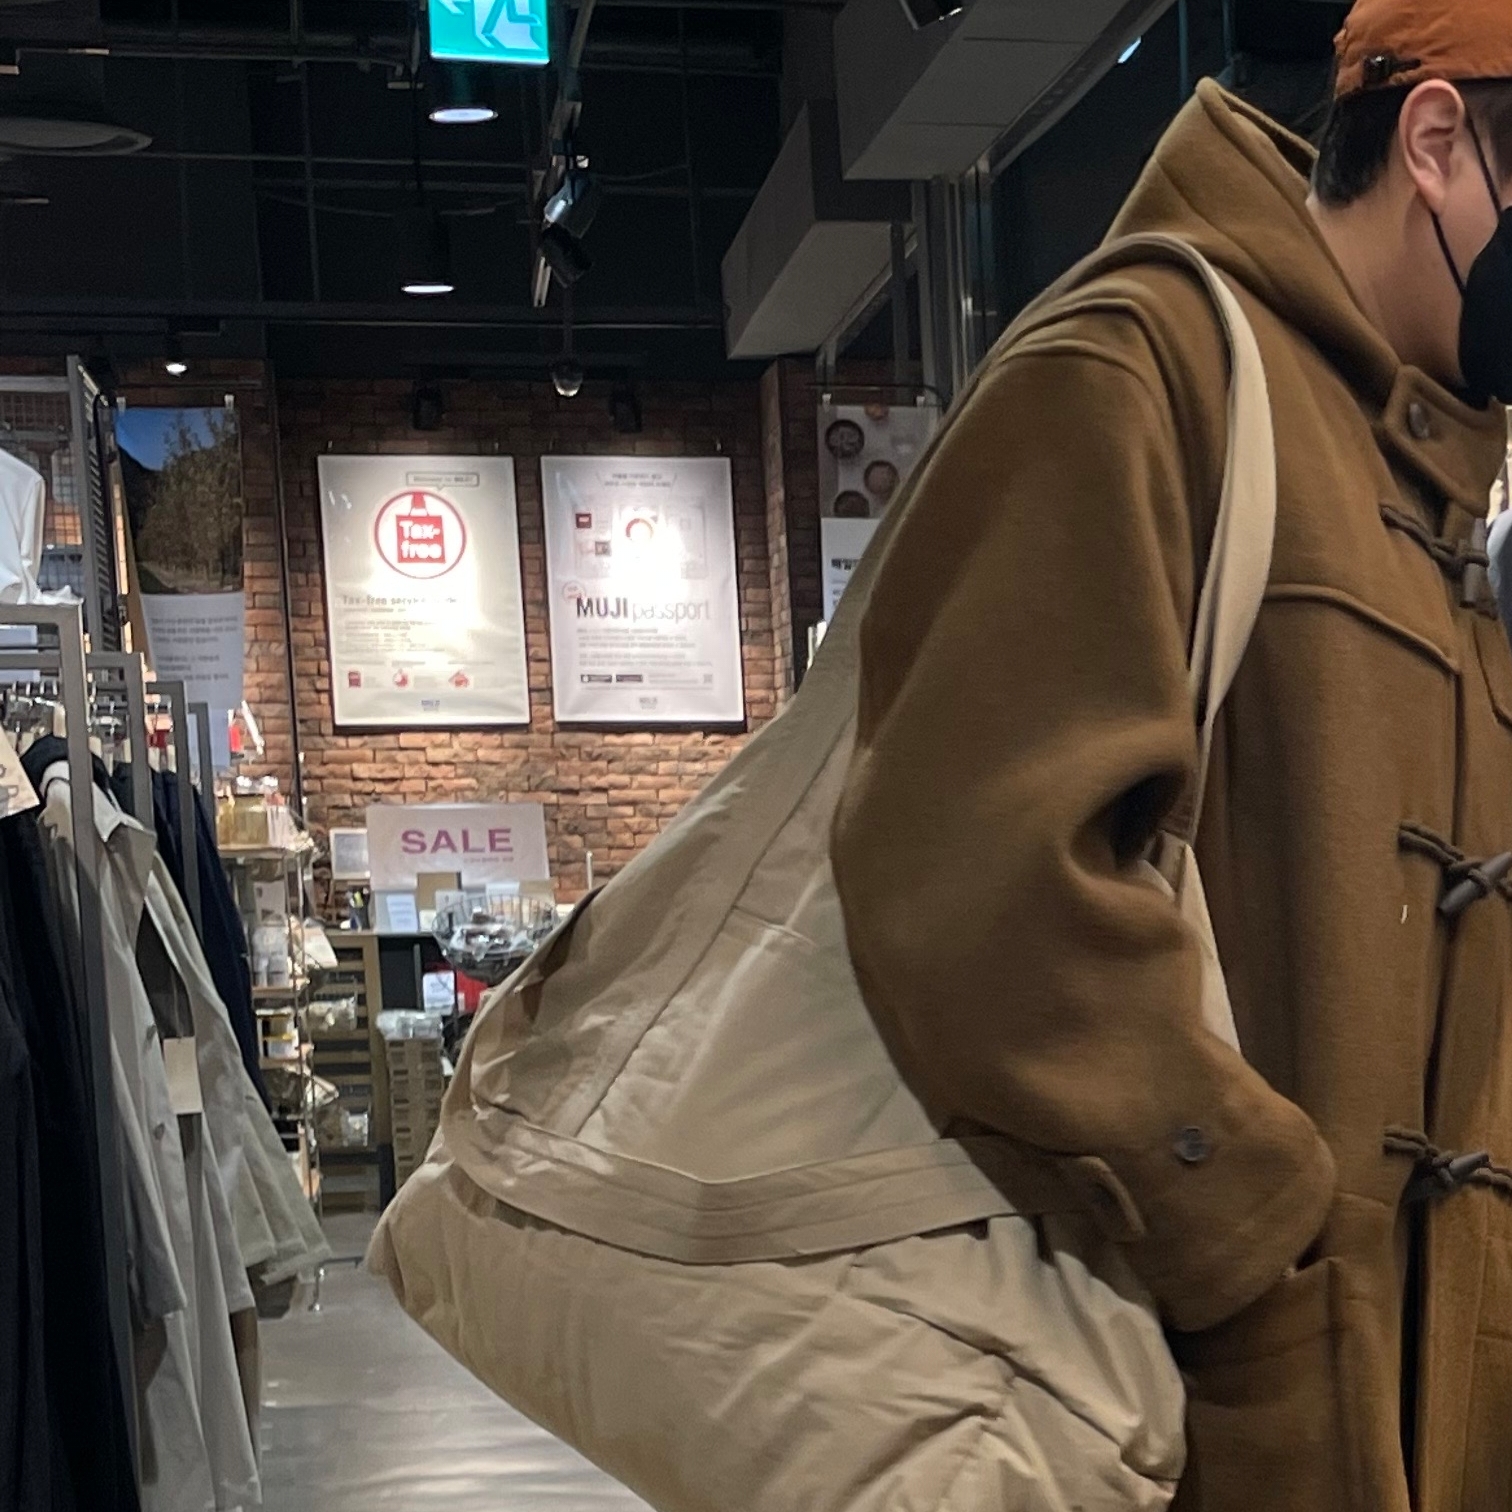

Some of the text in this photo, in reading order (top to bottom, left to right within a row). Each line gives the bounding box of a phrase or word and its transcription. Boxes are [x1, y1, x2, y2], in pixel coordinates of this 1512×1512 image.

[576, 597, 712, 624] MUJI passport
[401, 828, 514, 854] SALE
